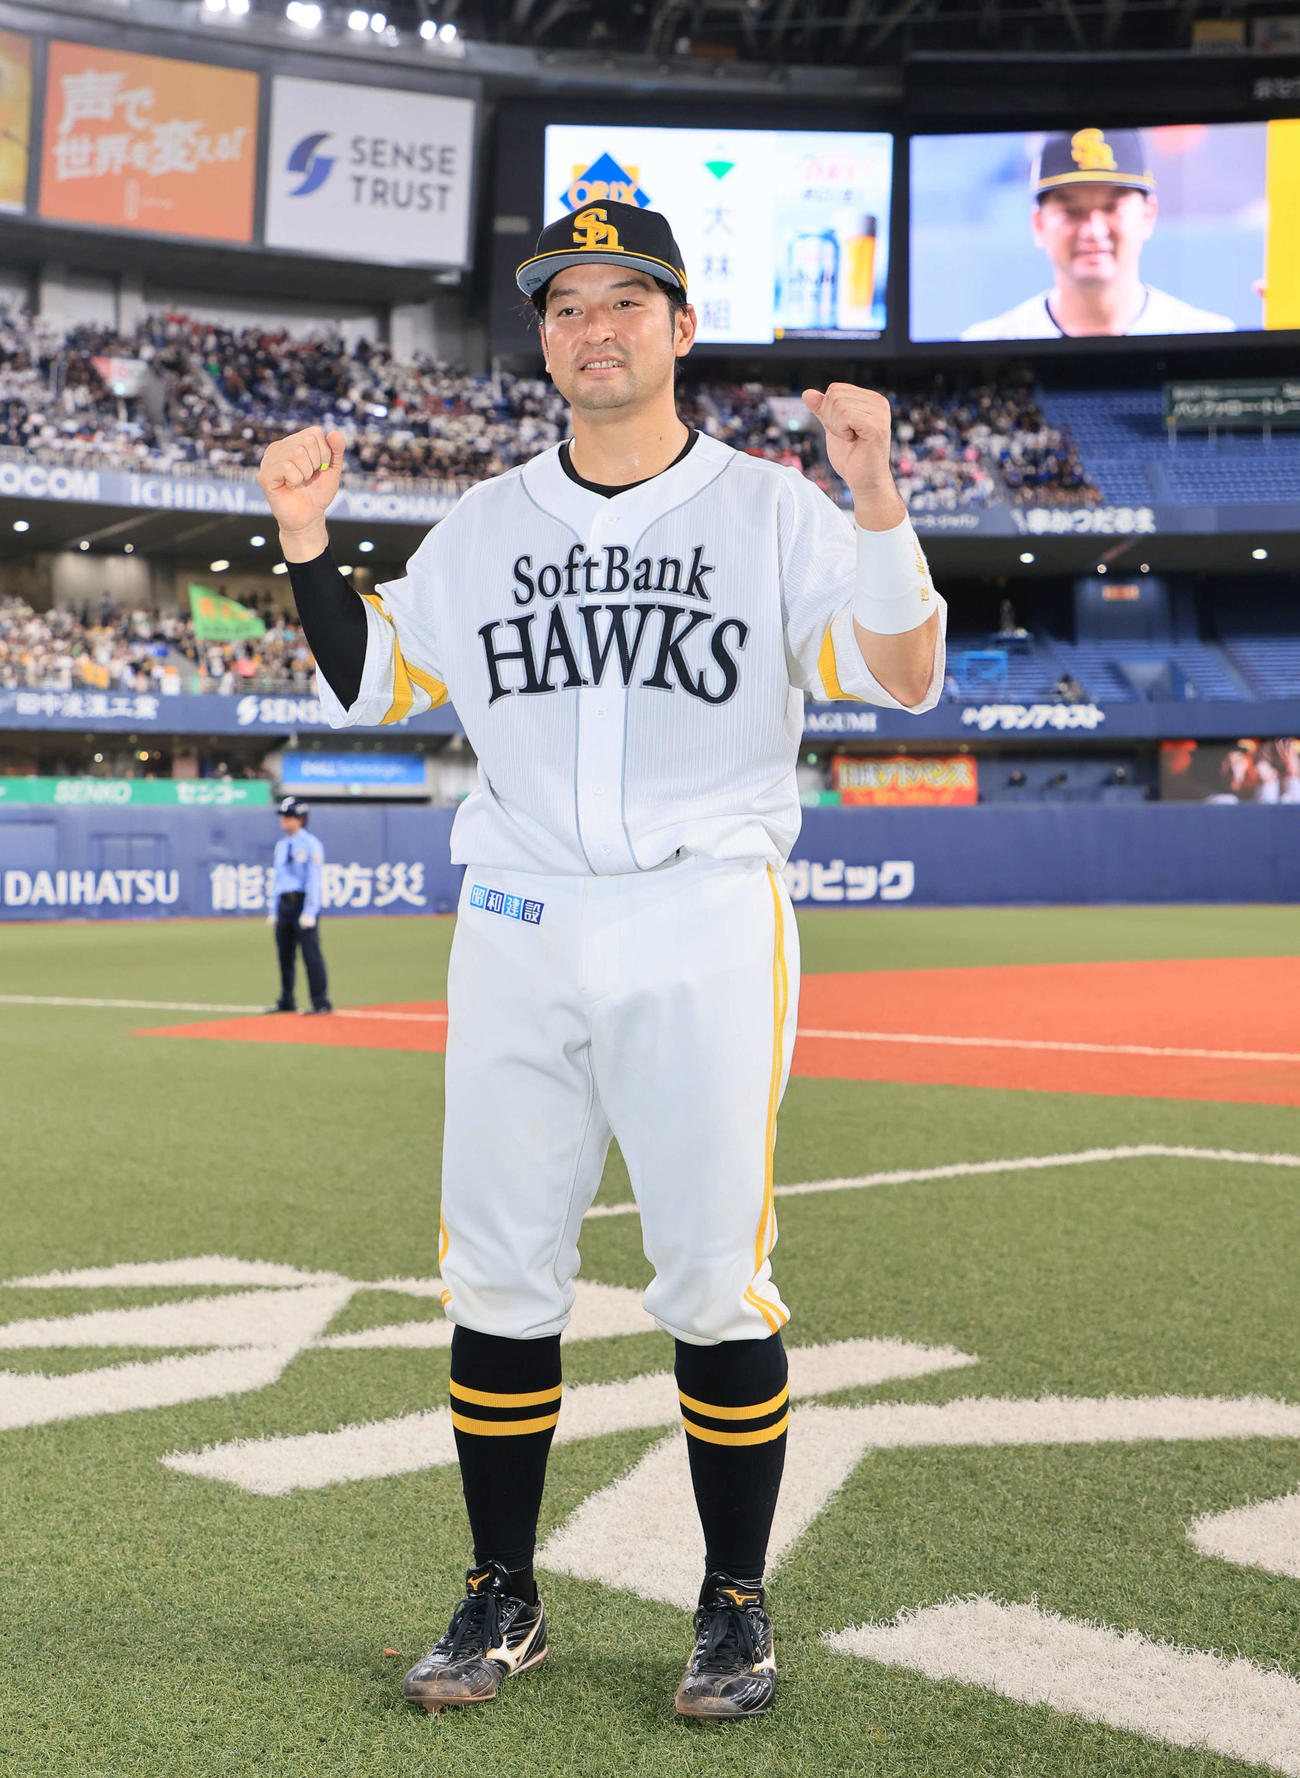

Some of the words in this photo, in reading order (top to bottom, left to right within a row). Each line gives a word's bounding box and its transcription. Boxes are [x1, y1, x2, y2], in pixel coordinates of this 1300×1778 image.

[57, 68, 156, 136] 声で
[351, 136, 457, 176] SENSE
[351, 175, 452, 213] TRUST
[702, 203, 737, 330] 大林組
[128, 472, 246, 513] ICHIDAI
[512, 543, 716, 606] SoftBank
[478, 601, 752, 708] HAWKS
[55, 780, 132, 804] SENKO
[176, 782, 248, 805] センコー
[4, 869, 180, 906] DAIHATSU
[210, 862, 427, 910] 能防災
[470, 885, 543, 924] 昭和建設
